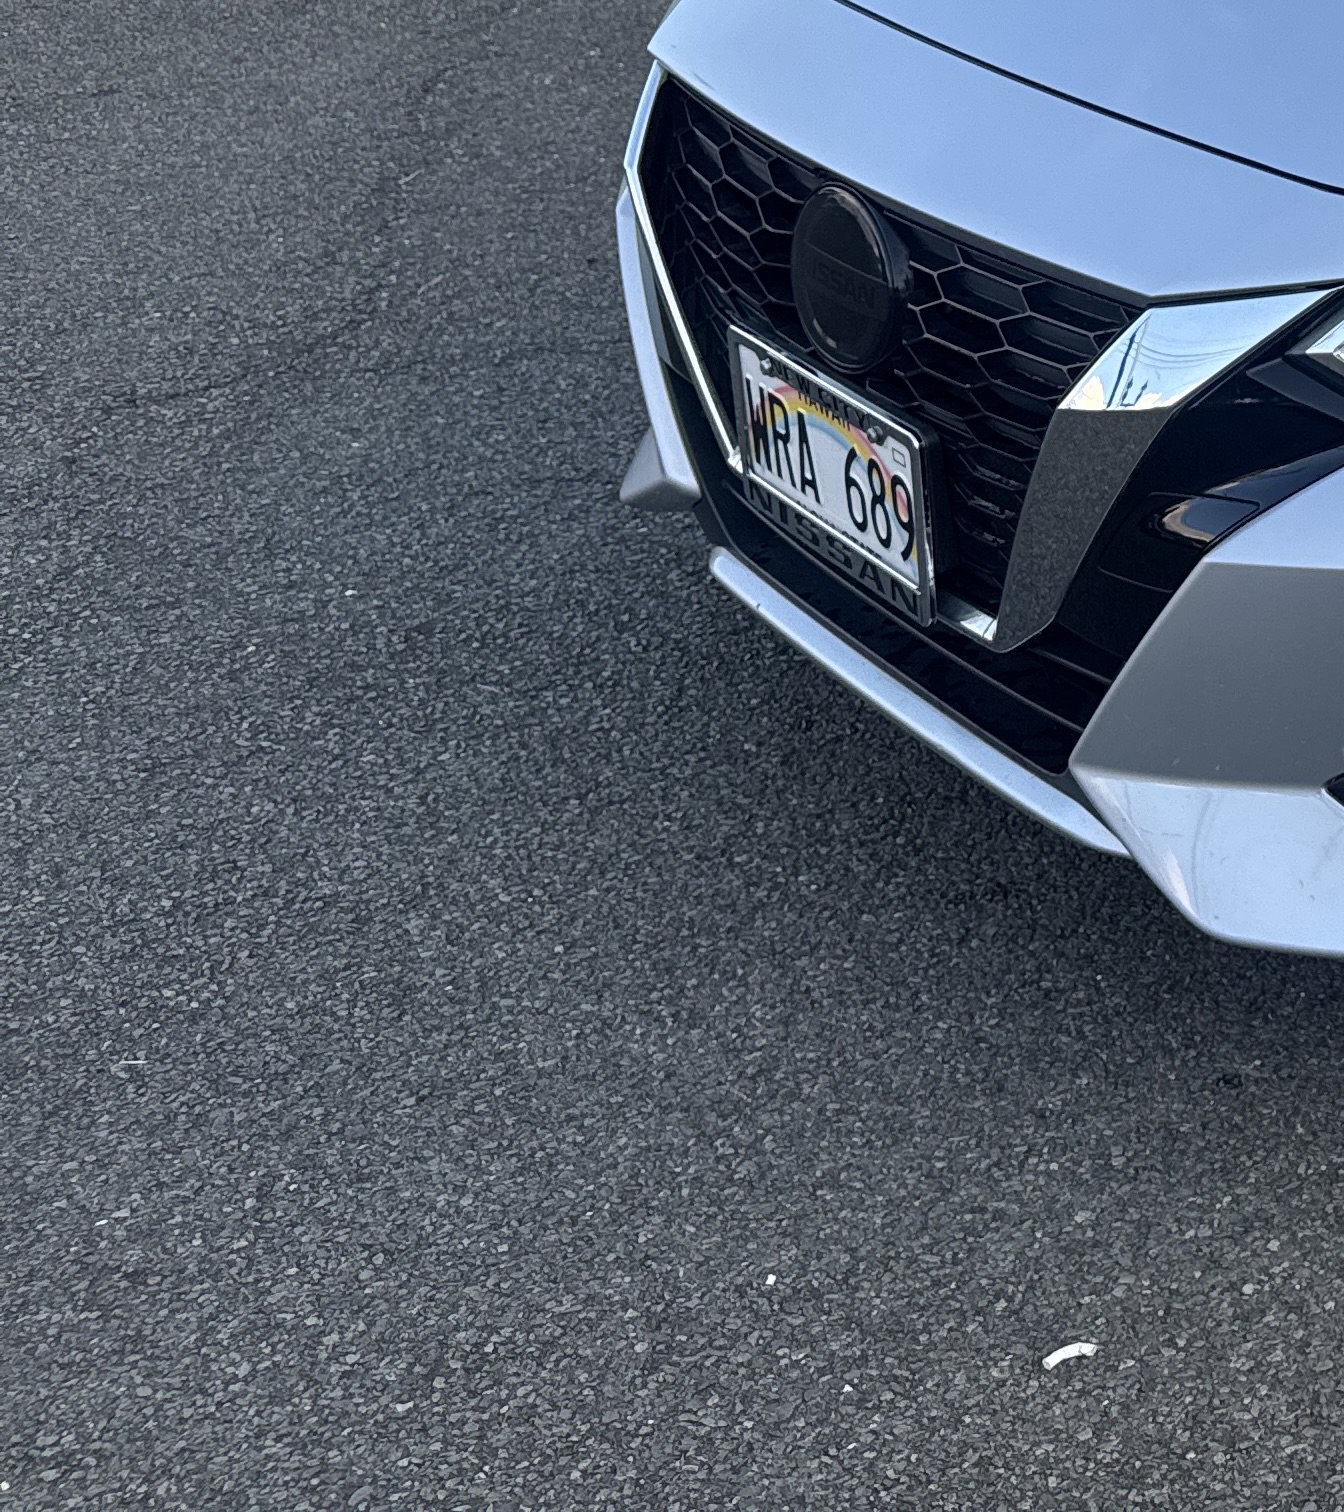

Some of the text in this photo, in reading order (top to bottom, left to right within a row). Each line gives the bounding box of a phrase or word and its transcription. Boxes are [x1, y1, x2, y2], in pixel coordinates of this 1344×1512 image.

[745, 373, 821, 505] WRA
[845, 445, 915, 562] 689
[749, 478, 918, 617] NISSAN
